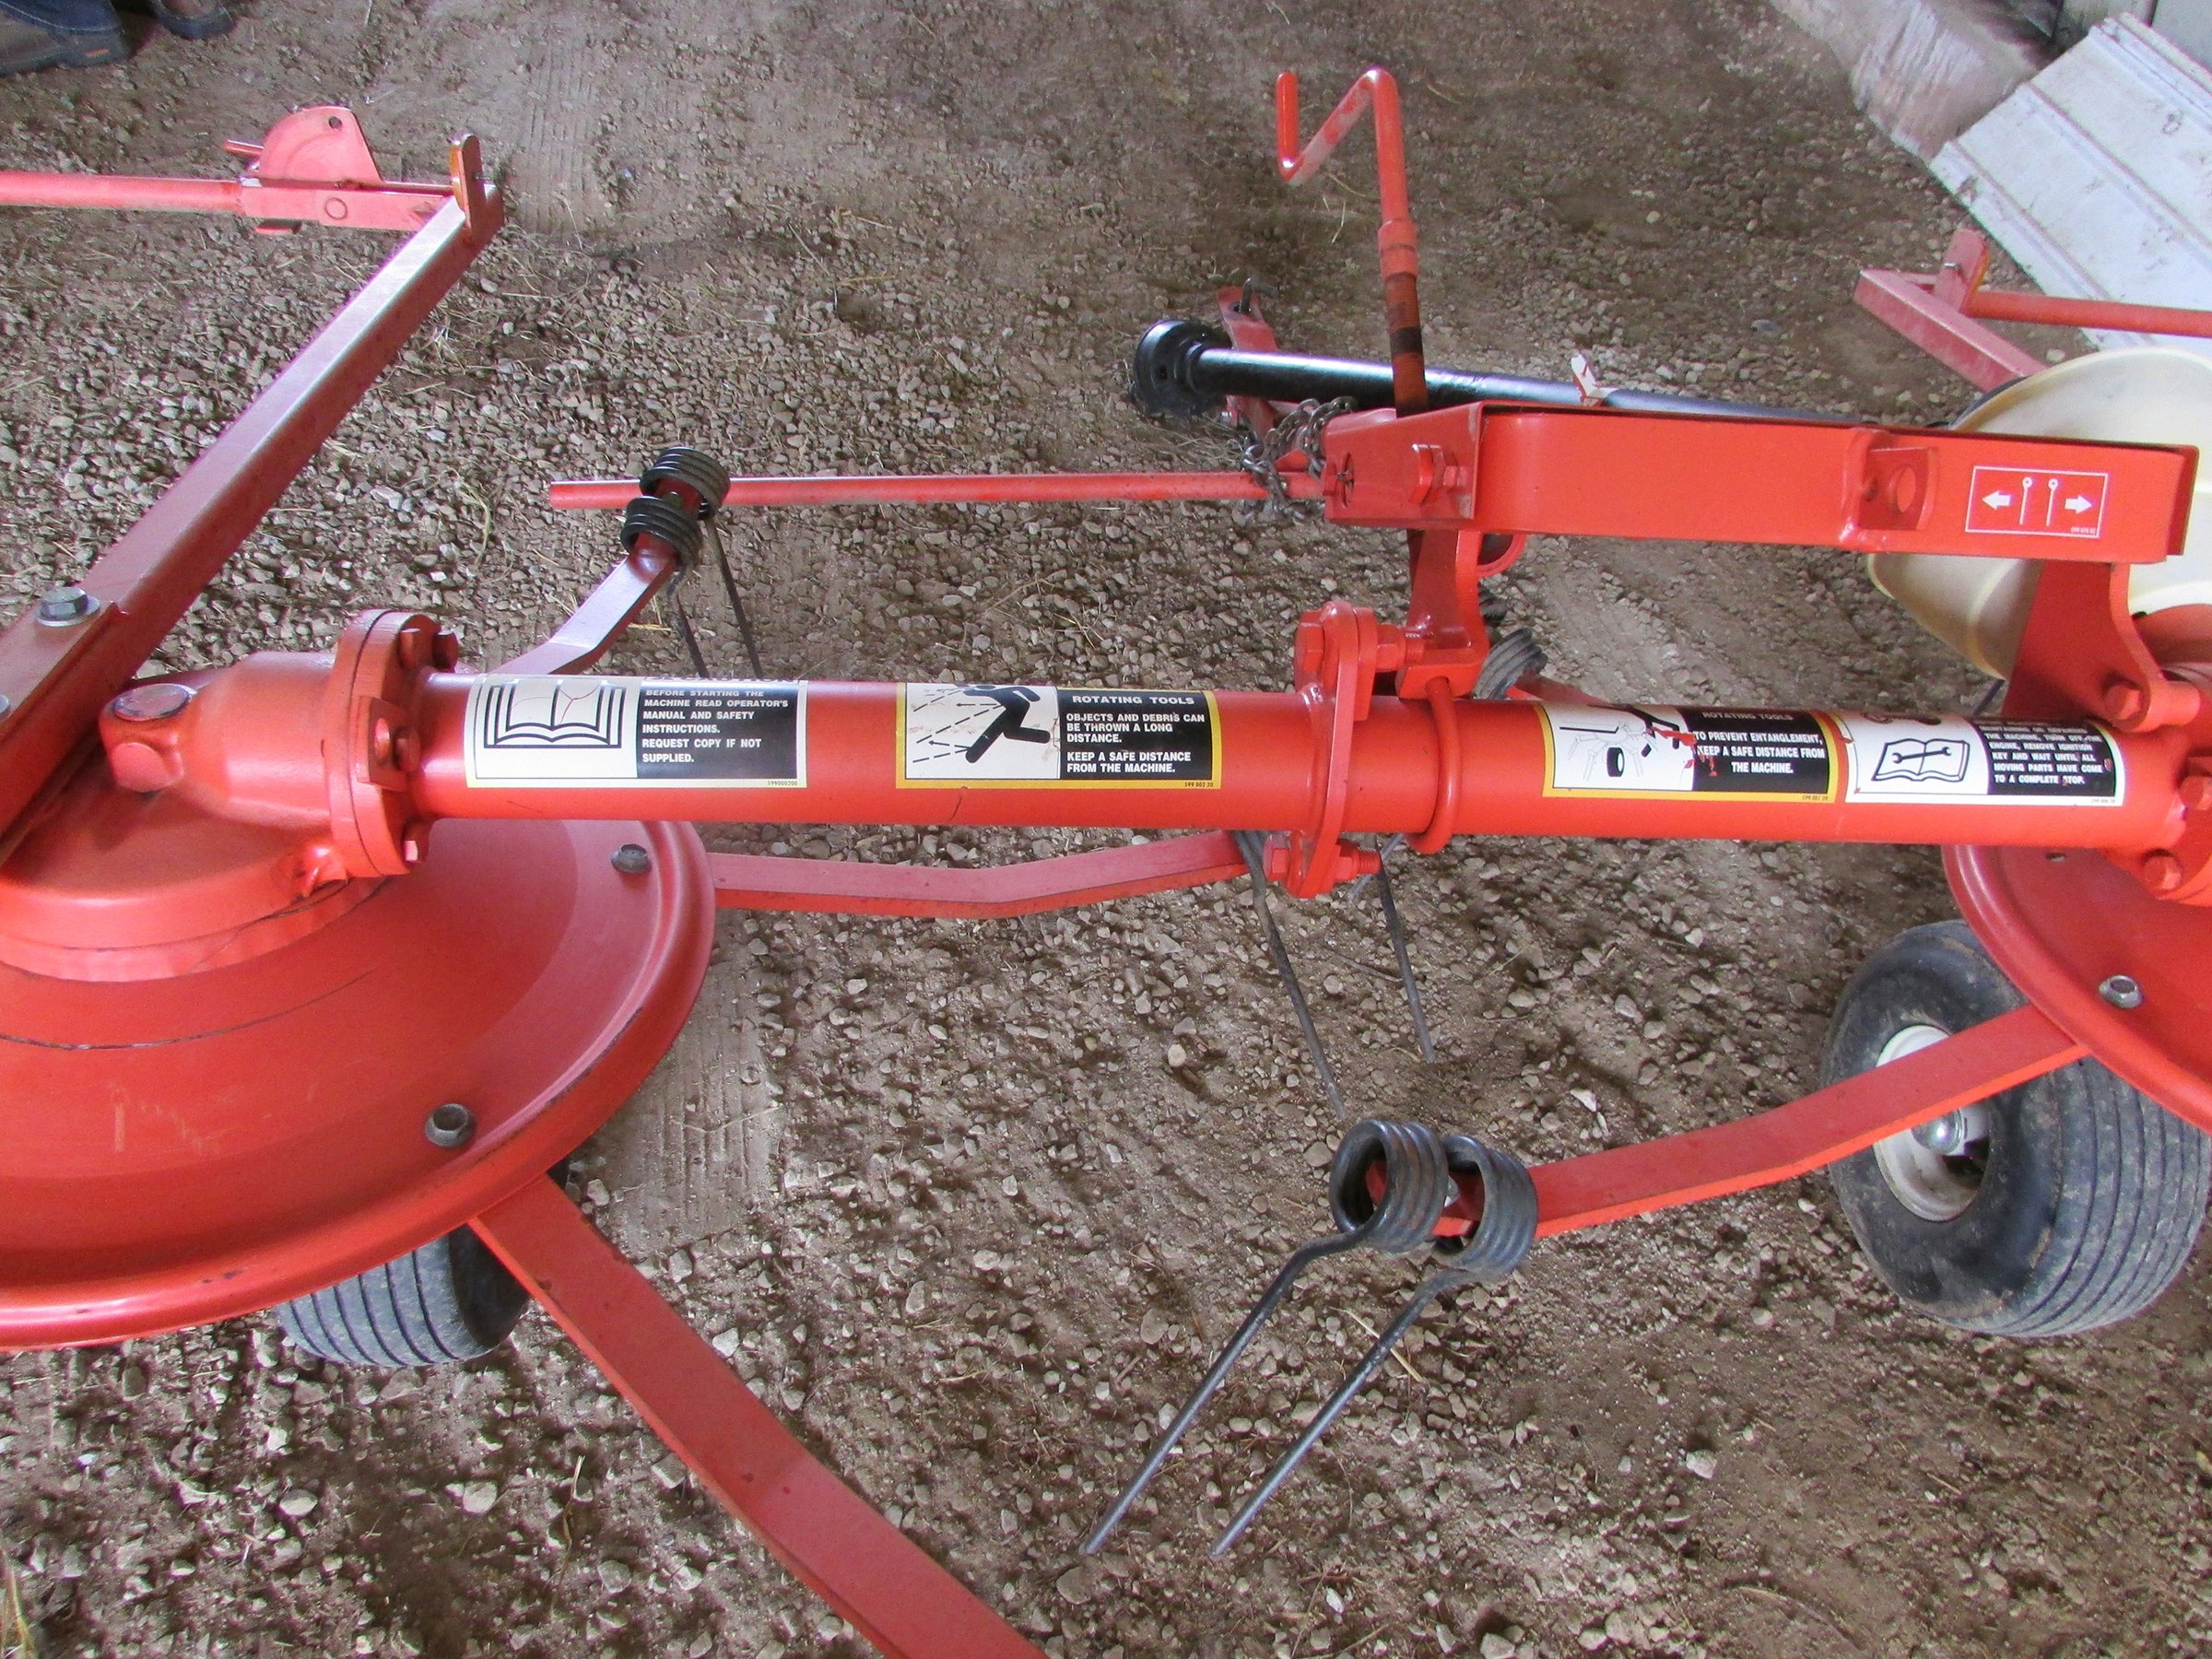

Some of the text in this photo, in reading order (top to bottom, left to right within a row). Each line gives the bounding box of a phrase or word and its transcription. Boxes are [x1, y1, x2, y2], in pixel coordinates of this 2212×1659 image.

[717, 712, 755, 720] SAFETY
[1066, 713, 1113, 722] OBJECTS
[1143, 713, 1180, 722] DEBRIS
[642, 724, 720, 733] INSTRUCTIONS.
[1067, 724, 1172, 732] BE THROWN A LONG
[1067, 734, 1122, 742] DISTANCE.
[1693, 731, 1822, 745] TO PREVENT ENTANGLEMENT,
[642, 739, 761, 748] REQUEST COPY IF NOT
[2057, 743, 2093, 751] IGNITION
[1067, 752, 1191, 761] KEEP A SAFE DISTANCE
[1697, 746, 1825, 759] KEEP A SAFE DISTANCE FROM
[2012, 752, 2028, 760] AND
[2031, 752, 2051, 760] WAIT
[2054, 753, 2078, 761] UNTIL
[2082, 753, 2096, 761] ALL
[642, 754, 694, 763] SUPPLIED.
[1067, 763, 1175, 772] FROM THE MACHINE.
[1731, 761, 1794, 774] THE MACHINE.
[1994, 763, 2025, 771] MOVING
[2056, 764, 2077, 772] HAVE
[2081, 765, 2103, 773] COME
[1994, 774, 2006, 782] TO
[2018, 775, 2058, 783] COMPLETE
